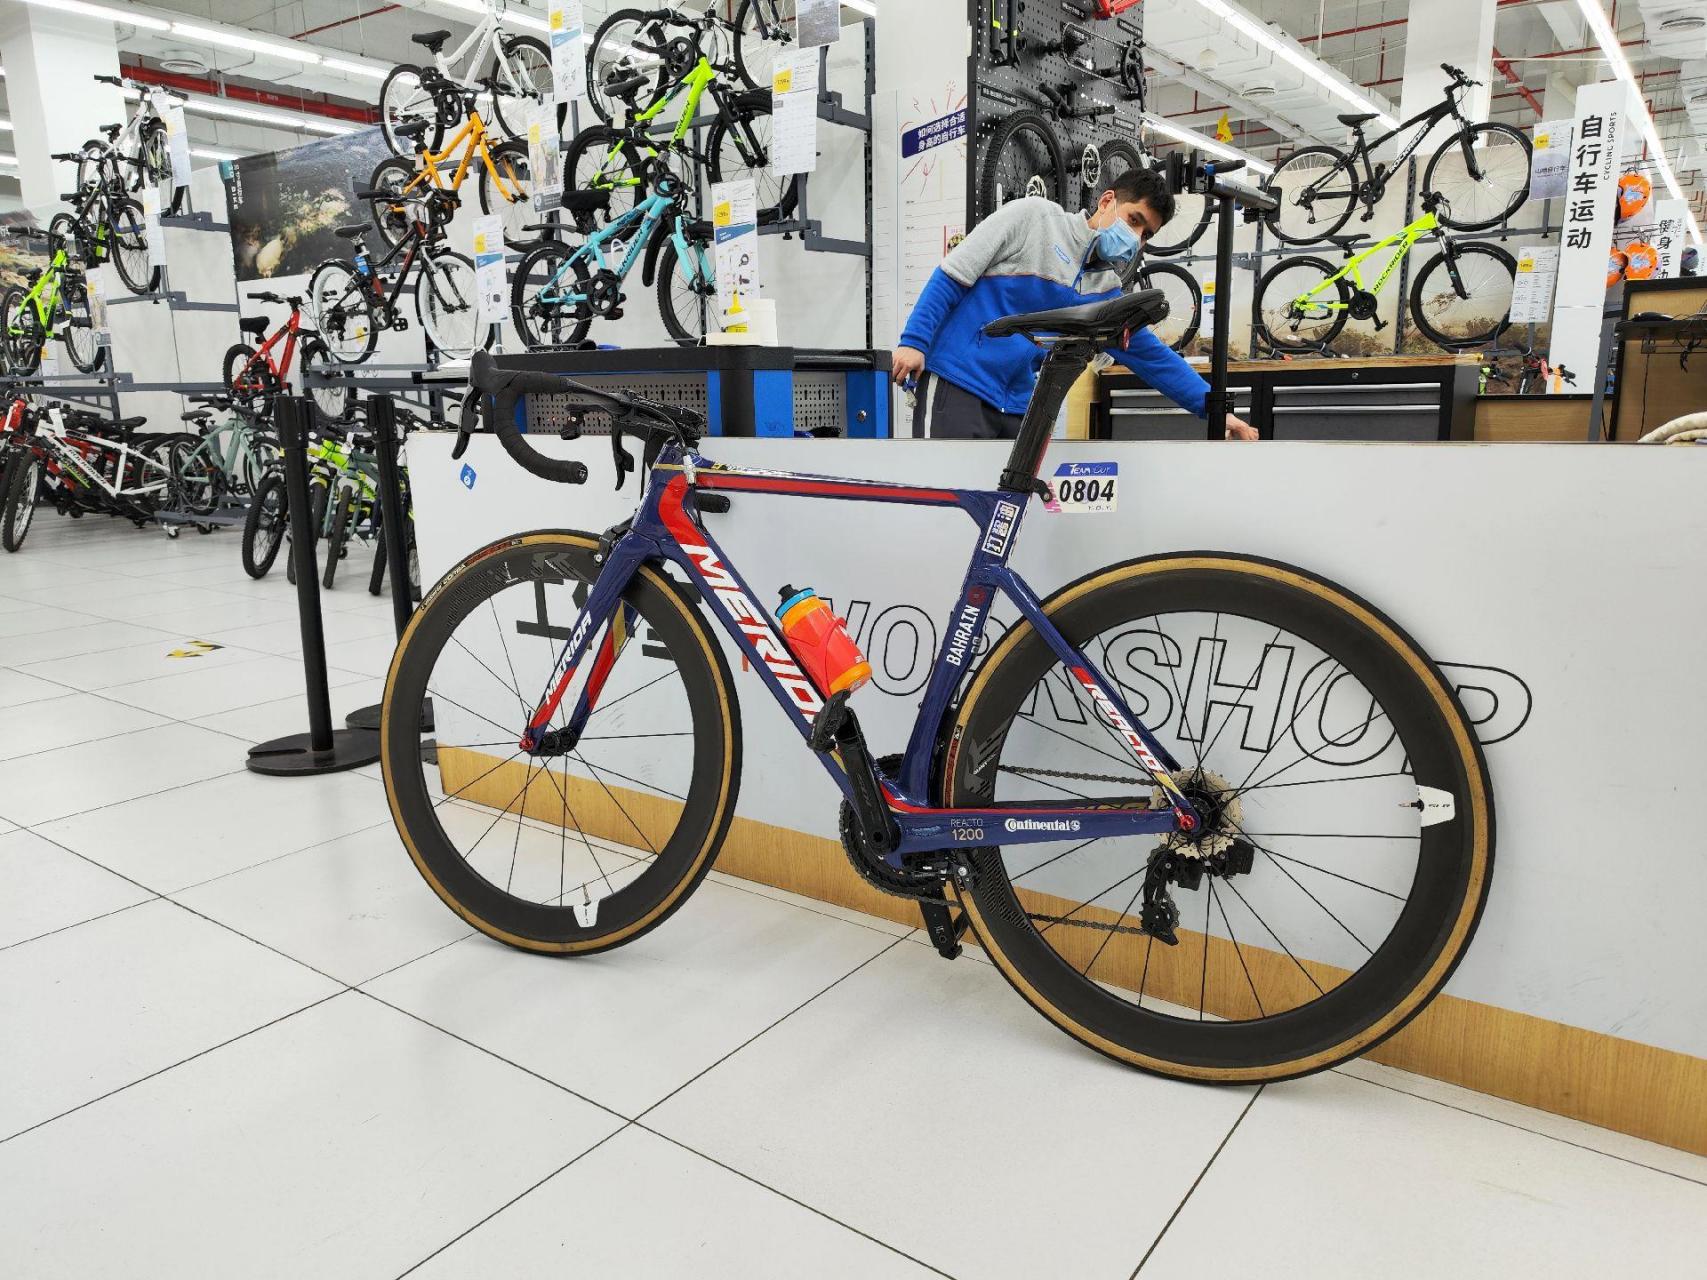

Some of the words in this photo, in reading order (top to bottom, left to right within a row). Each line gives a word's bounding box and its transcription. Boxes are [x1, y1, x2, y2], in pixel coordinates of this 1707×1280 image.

[918, 112, 966, 139] 如何选择合适
[918, 125, 966, 152] 身高的自行车
[1607, 111, 1617, 143] SPORTS
[1603, 145, 1613, 181] CYCLING
[1567, 115, 1602, 249] 自行车运动
[1373, 240, 1409, 292] ROCKRIDER
[1069, 463, 1091, 476] TEAM
[1060, 479, 1115, 503] 0804
[679, 543, 828, 725] MERID
[946, 604, 981, 667] BAHRAIN
[544, 610, 592, 706] MERIDA
[816, 595, 1532, 777] OSHOP
[1082, 682, 1166, 773] REACTO
[951, 818, 984, 828] REACTO
[951, 828, 985, 842] 1200
[1004, 818, 1071, 832] Continental
